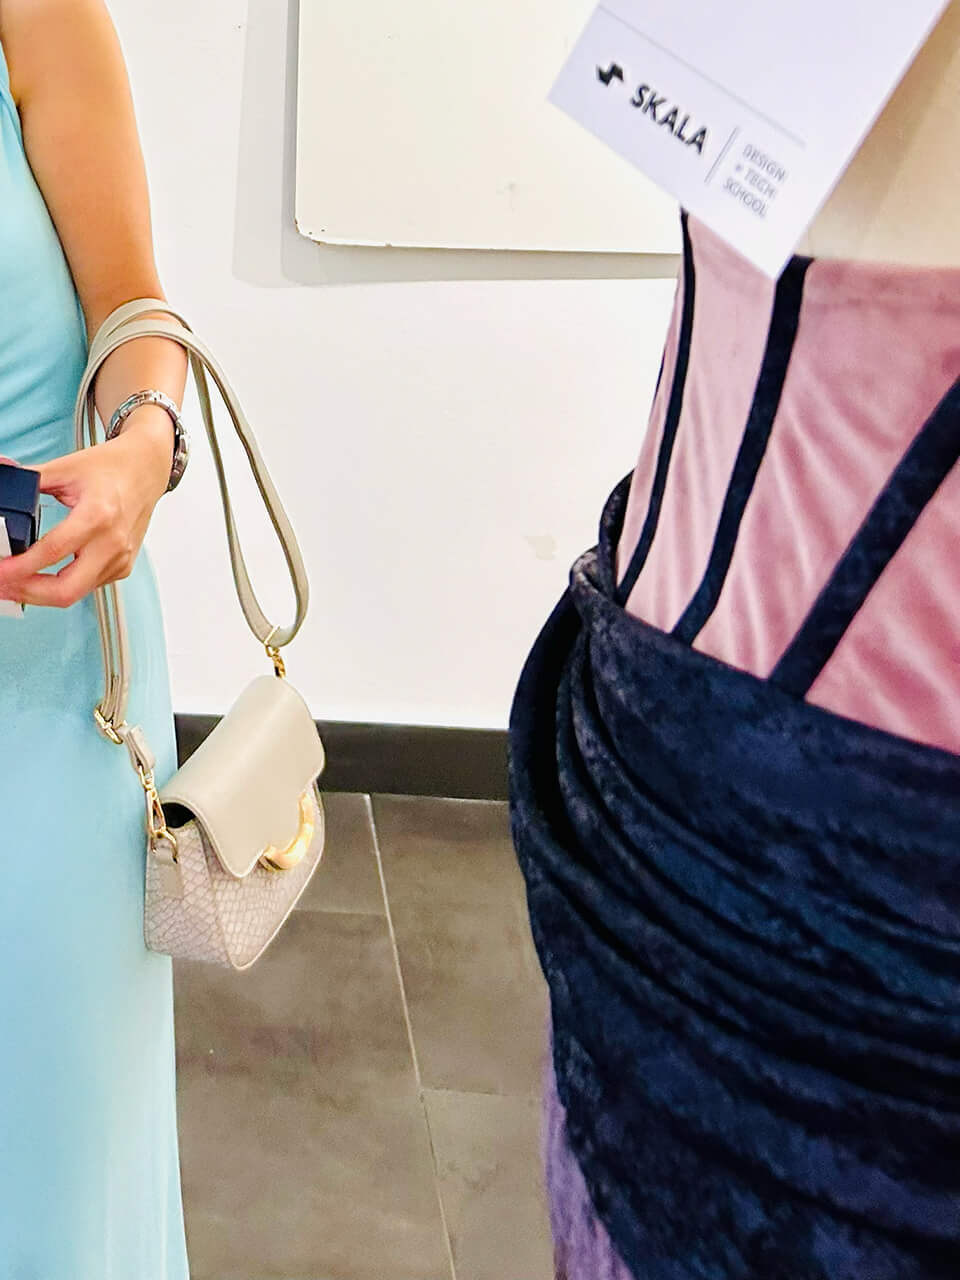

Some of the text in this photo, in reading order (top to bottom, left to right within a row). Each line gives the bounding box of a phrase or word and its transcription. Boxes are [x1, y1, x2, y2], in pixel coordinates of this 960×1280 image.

[630, 83, 708, 155] SKALA
[743, 144, 786, 182] DESIGN
[723, 178, 767, 218] SCHOOL
[744, 168, 776, 199] TECH
